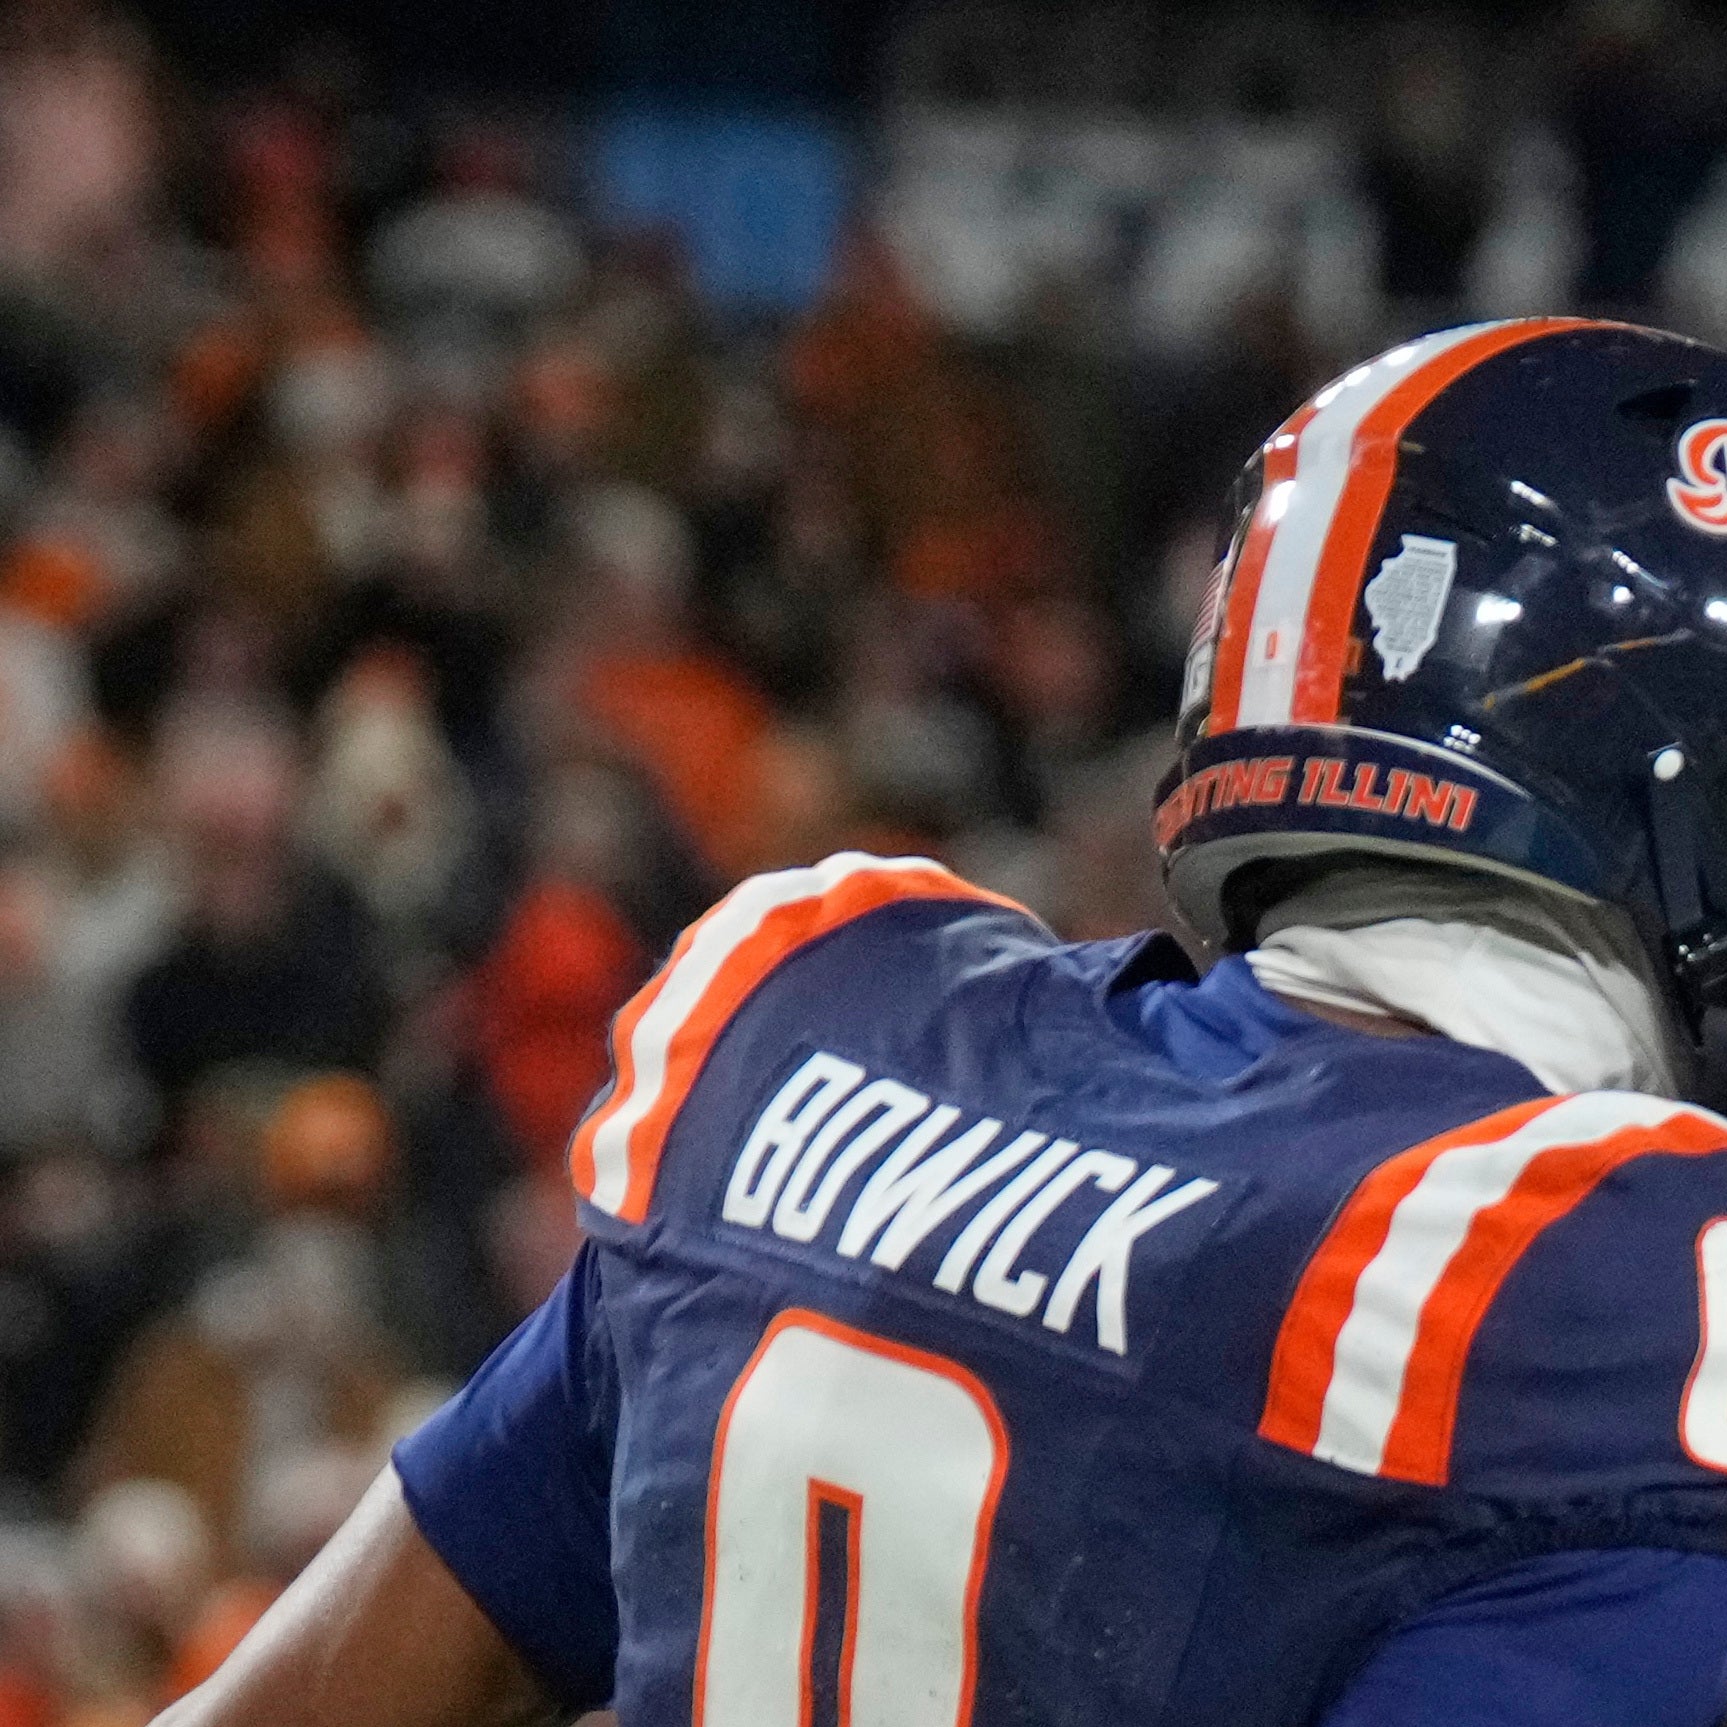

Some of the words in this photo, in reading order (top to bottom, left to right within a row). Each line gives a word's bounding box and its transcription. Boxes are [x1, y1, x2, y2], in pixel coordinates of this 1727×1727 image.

[1154, 756, 1294, 847] TING
[1298, 758, 1478, 832] ILLINI
[721, 1050, 1219, 1357] BOWICK
